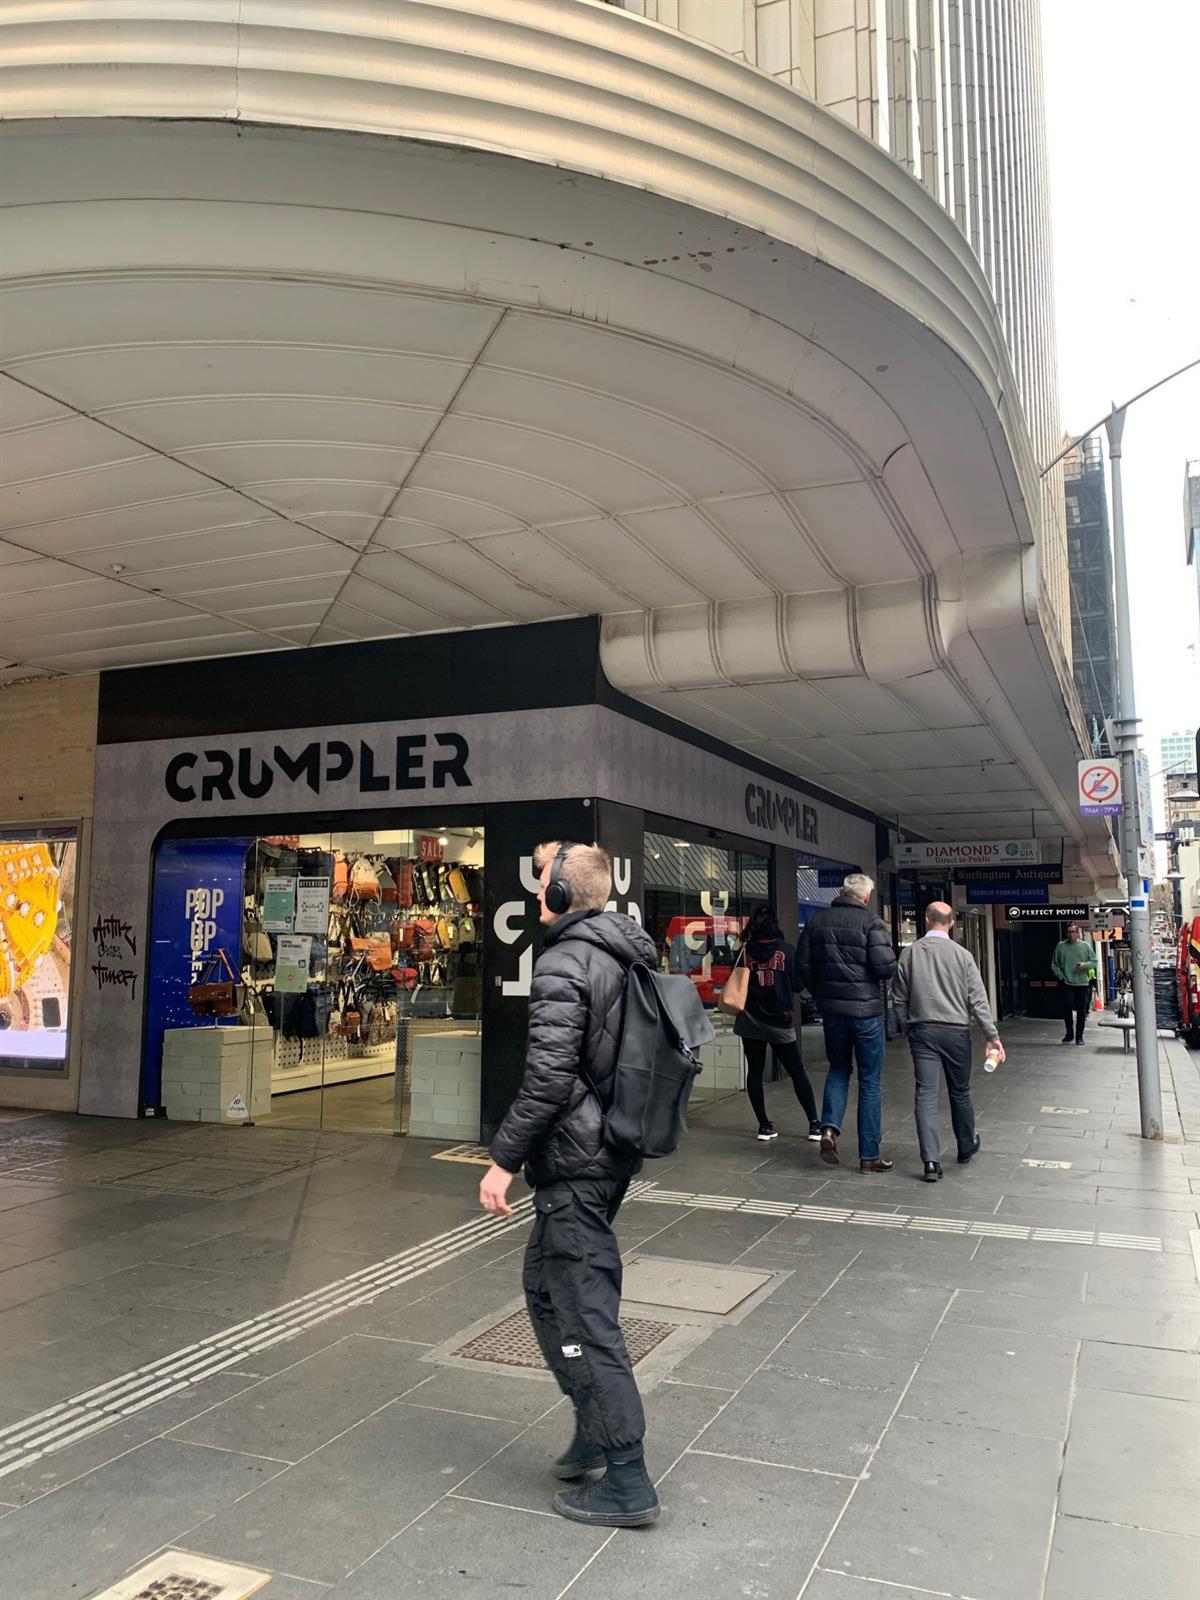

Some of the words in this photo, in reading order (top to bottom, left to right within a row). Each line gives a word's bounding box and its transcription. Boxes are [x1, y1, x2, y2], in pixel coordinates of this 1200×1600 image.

[164, 732, 473, 803] CRUMPLER
[744, 782, 819, 845] CRUMPLER
[926, 844, 999, 857] DIAMONDS
[935, 856, 957, 864] Direct
[968, 855, 991, 863] Public
[185, 889, 224, 919] POP
[1056, 908, 1085, 916] POTION
